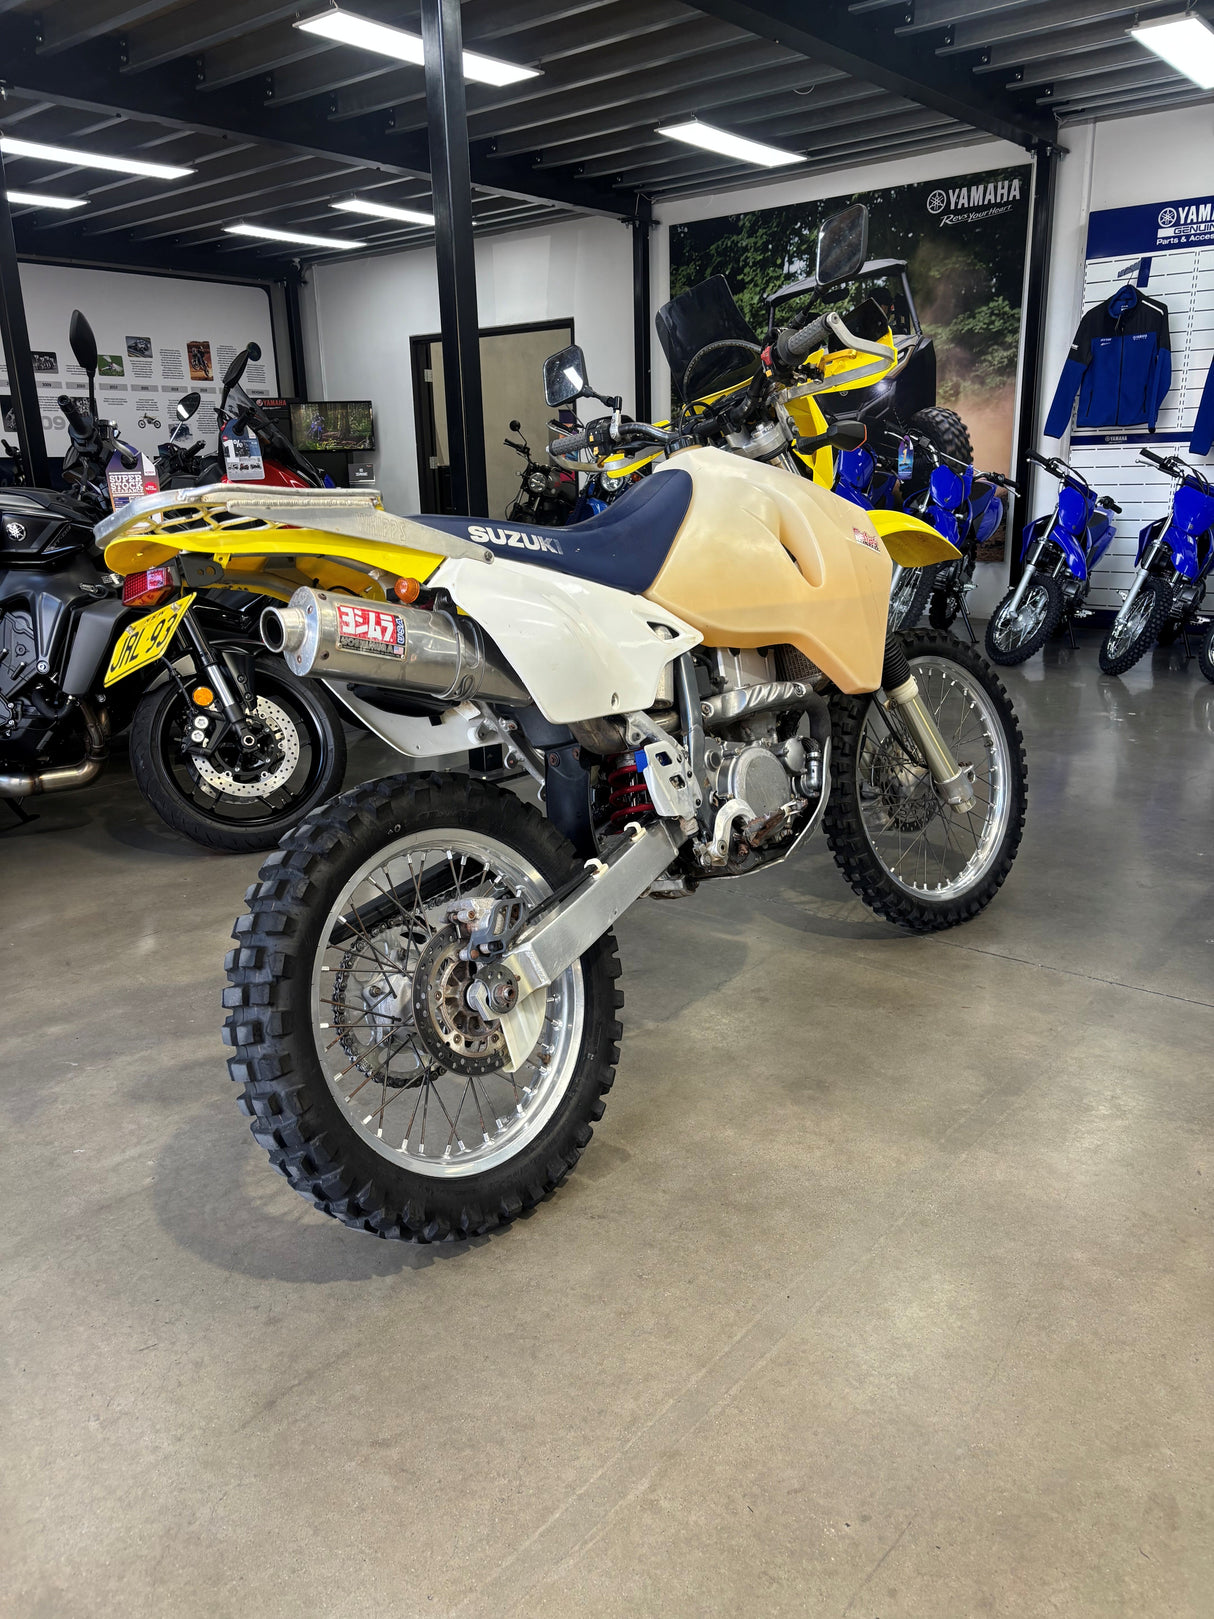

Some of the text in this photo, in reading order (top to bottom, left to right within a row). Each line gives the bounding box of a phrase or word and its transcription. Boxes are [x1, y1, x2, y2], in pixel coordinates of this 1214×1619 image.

[948, 179, 1021, 210] YAMAHA
[939, 203, 1014, 227] Revs Your Heart
[1156, 238, 1179, 246] Parts
[109, 474, 143, 483] SUPER
[111, 482, 144, 490] STOCK
[467, 525, 563, 555] SUZUKI
[339, 606, 394, 643] ヨシムラ
[395, 618, 405, 645] USA
[110, 613, 179, 673] JRL 93
